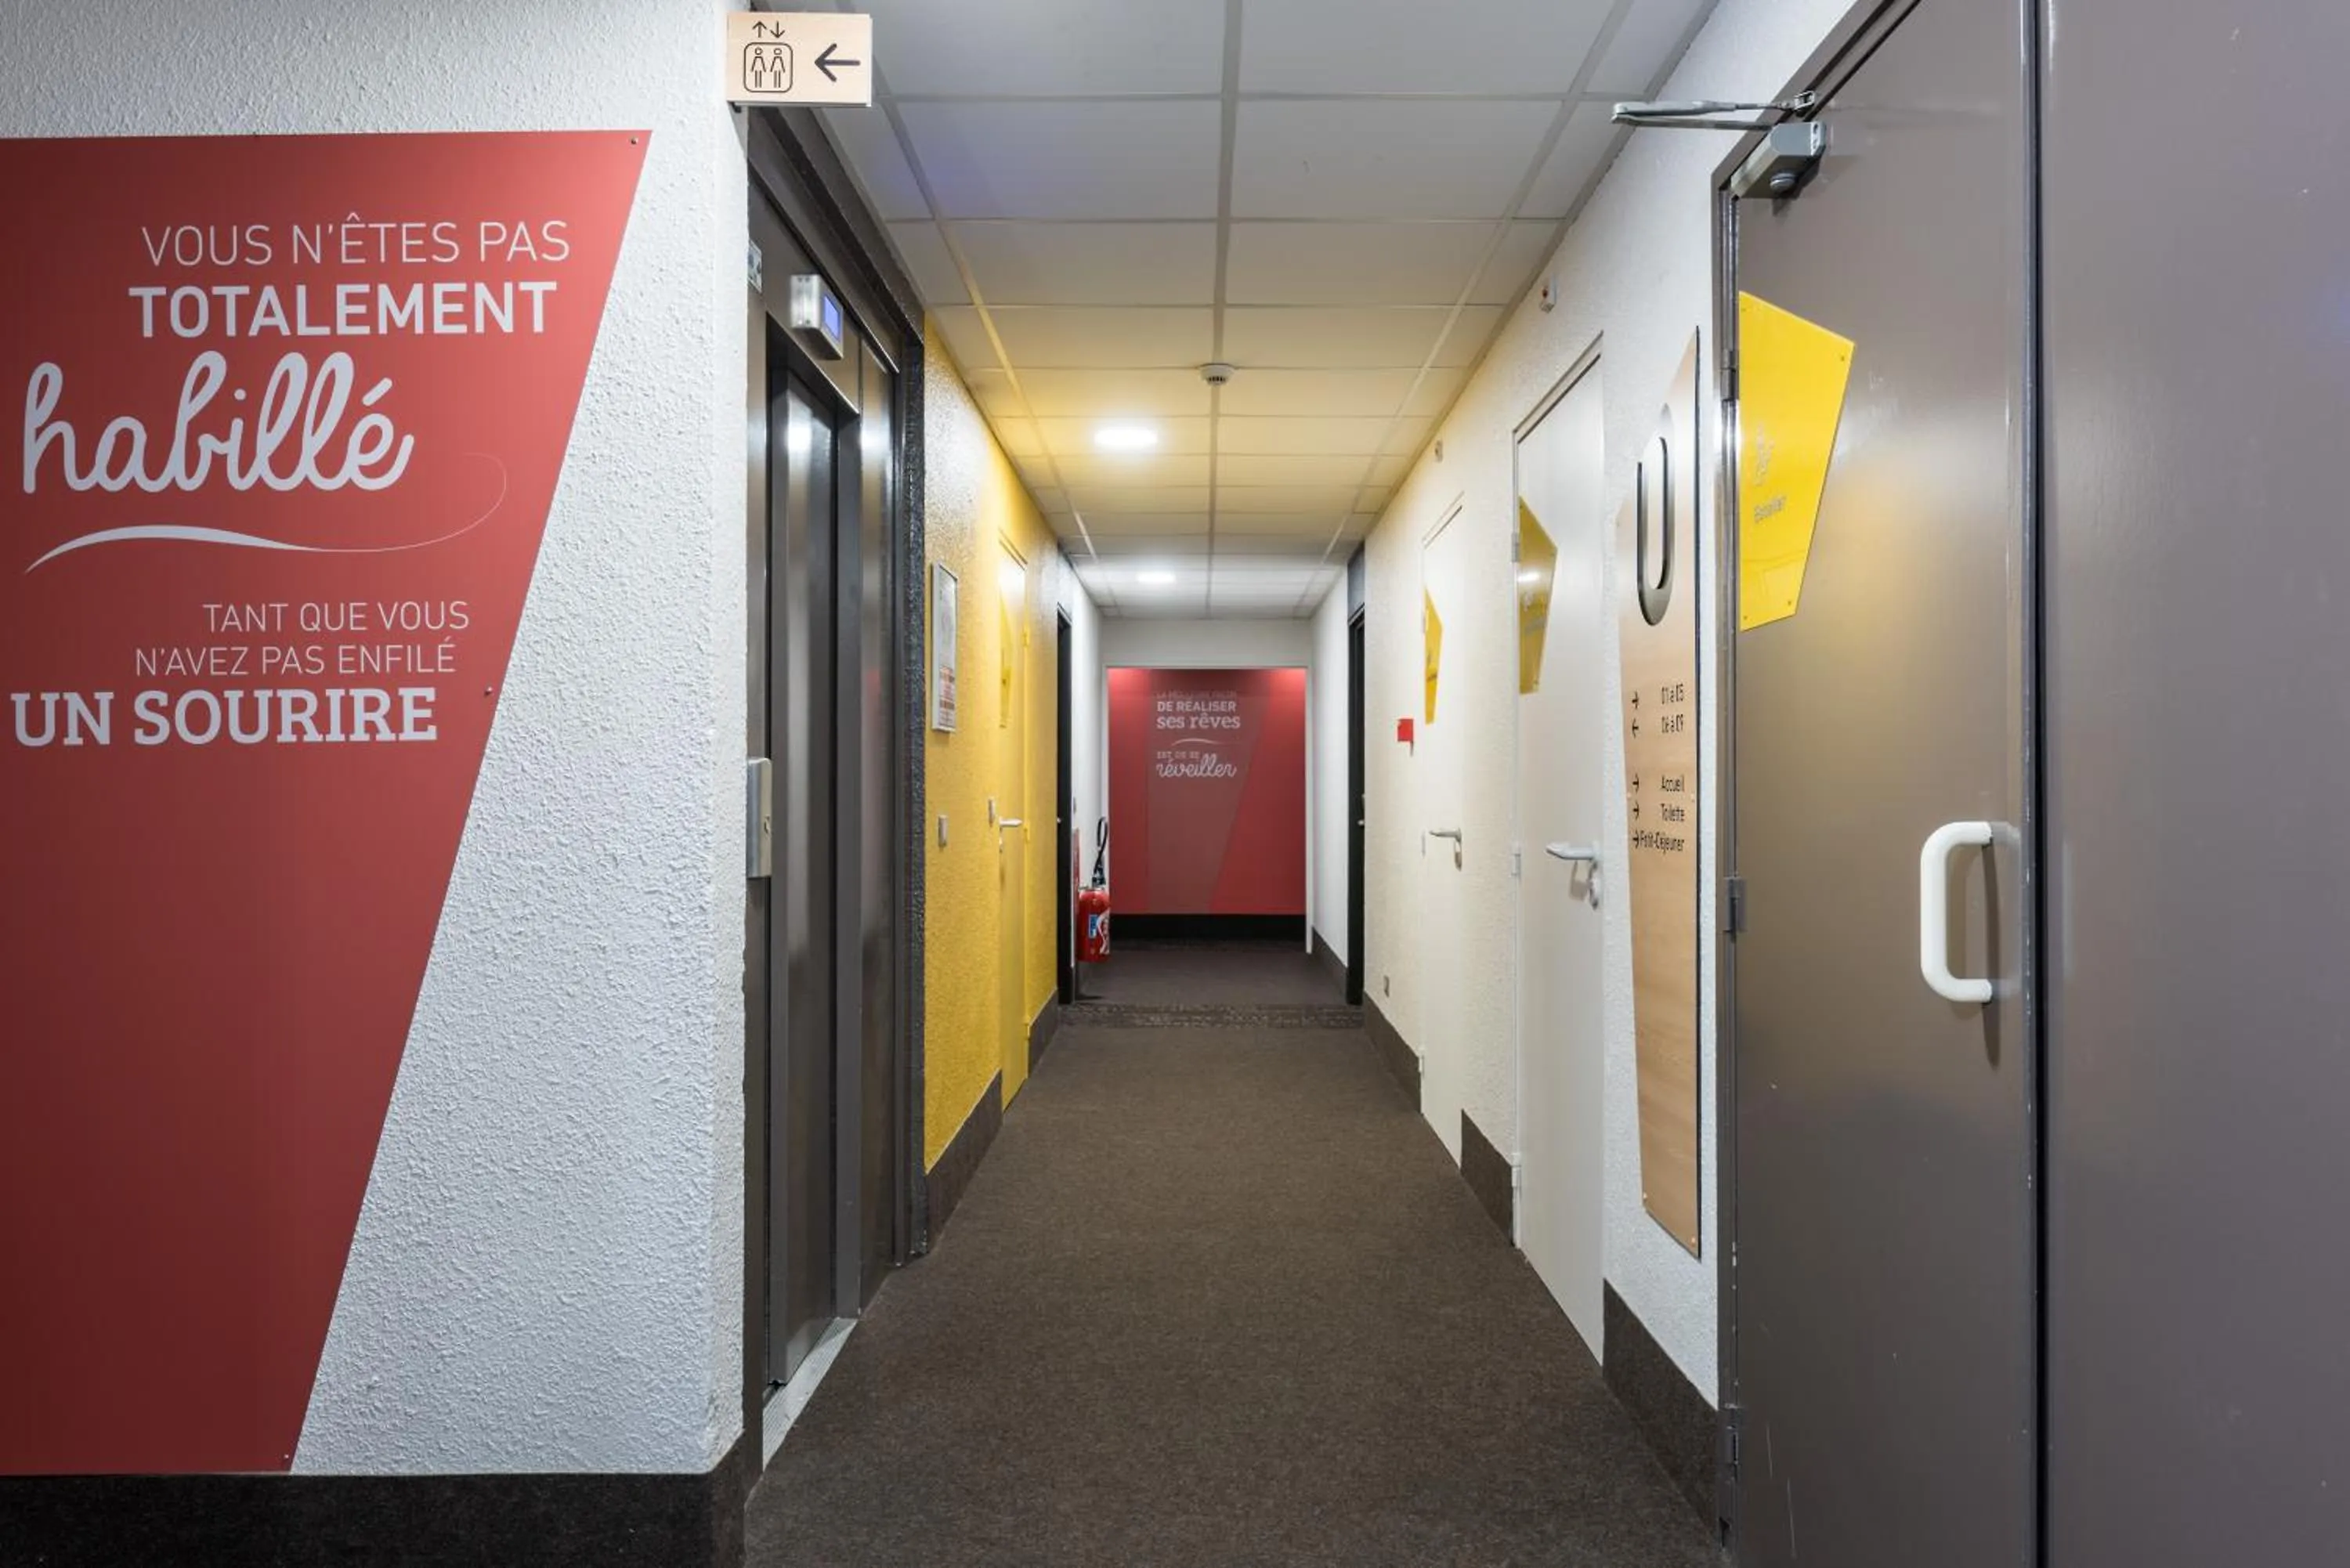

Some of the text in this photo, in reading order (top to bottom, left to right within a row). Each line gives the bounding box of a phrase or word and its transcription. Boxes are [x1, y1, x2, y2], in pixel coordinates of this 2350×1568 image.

[142, 224, 273, 266] VOUS
[479, 220, 570, 262] PAS
[128, 280, 557, 338] TOTALEMENT
[23, 350, 414, 494] habillé
[203, 601, 470, 632] TANT QUE VOUS
[262, 645, 325, 674] PAS
[338, 636, 456, 674] ENFILÉ
[11, 686, 438, 746] UN SOURIRE
[1156, 712, 1241, 729] ses rêves
[1157, 701, 1173, 712] DE
[1155, 753, 1238, 778] réveiller
[1661, 775, 1685, 792] Accueil
